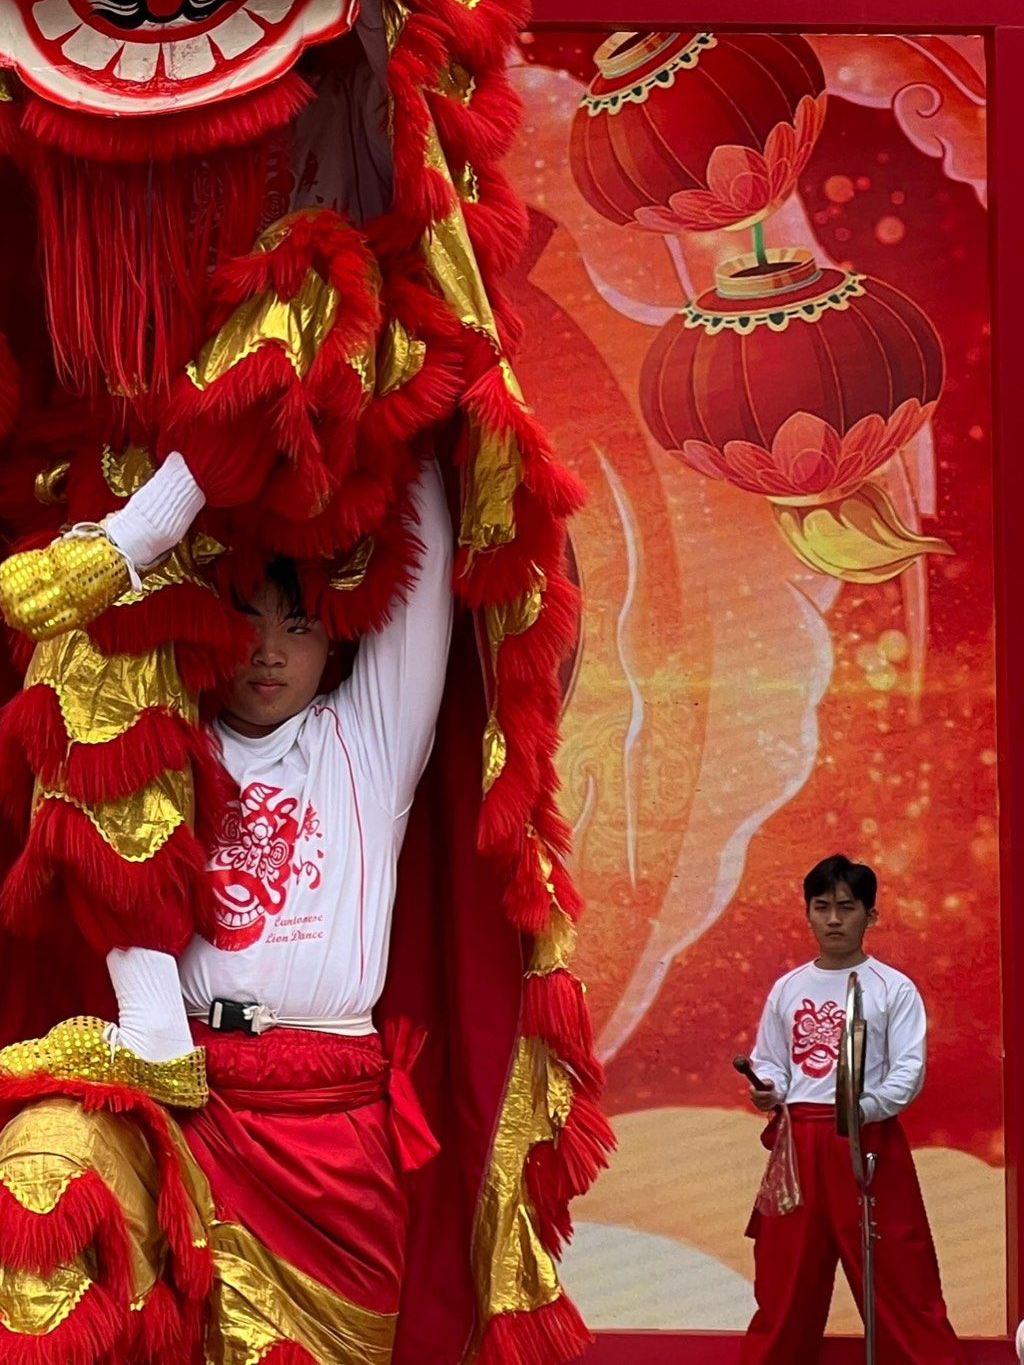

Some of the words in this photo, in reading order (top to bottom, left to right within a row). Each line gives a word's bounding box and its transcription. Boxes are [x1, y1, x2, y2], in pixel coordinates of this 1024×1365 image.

[274, 915, 323, 927] Cantonese
[265, 933, 288, 943] Lion
[291, 930, 323, 941] Dance
